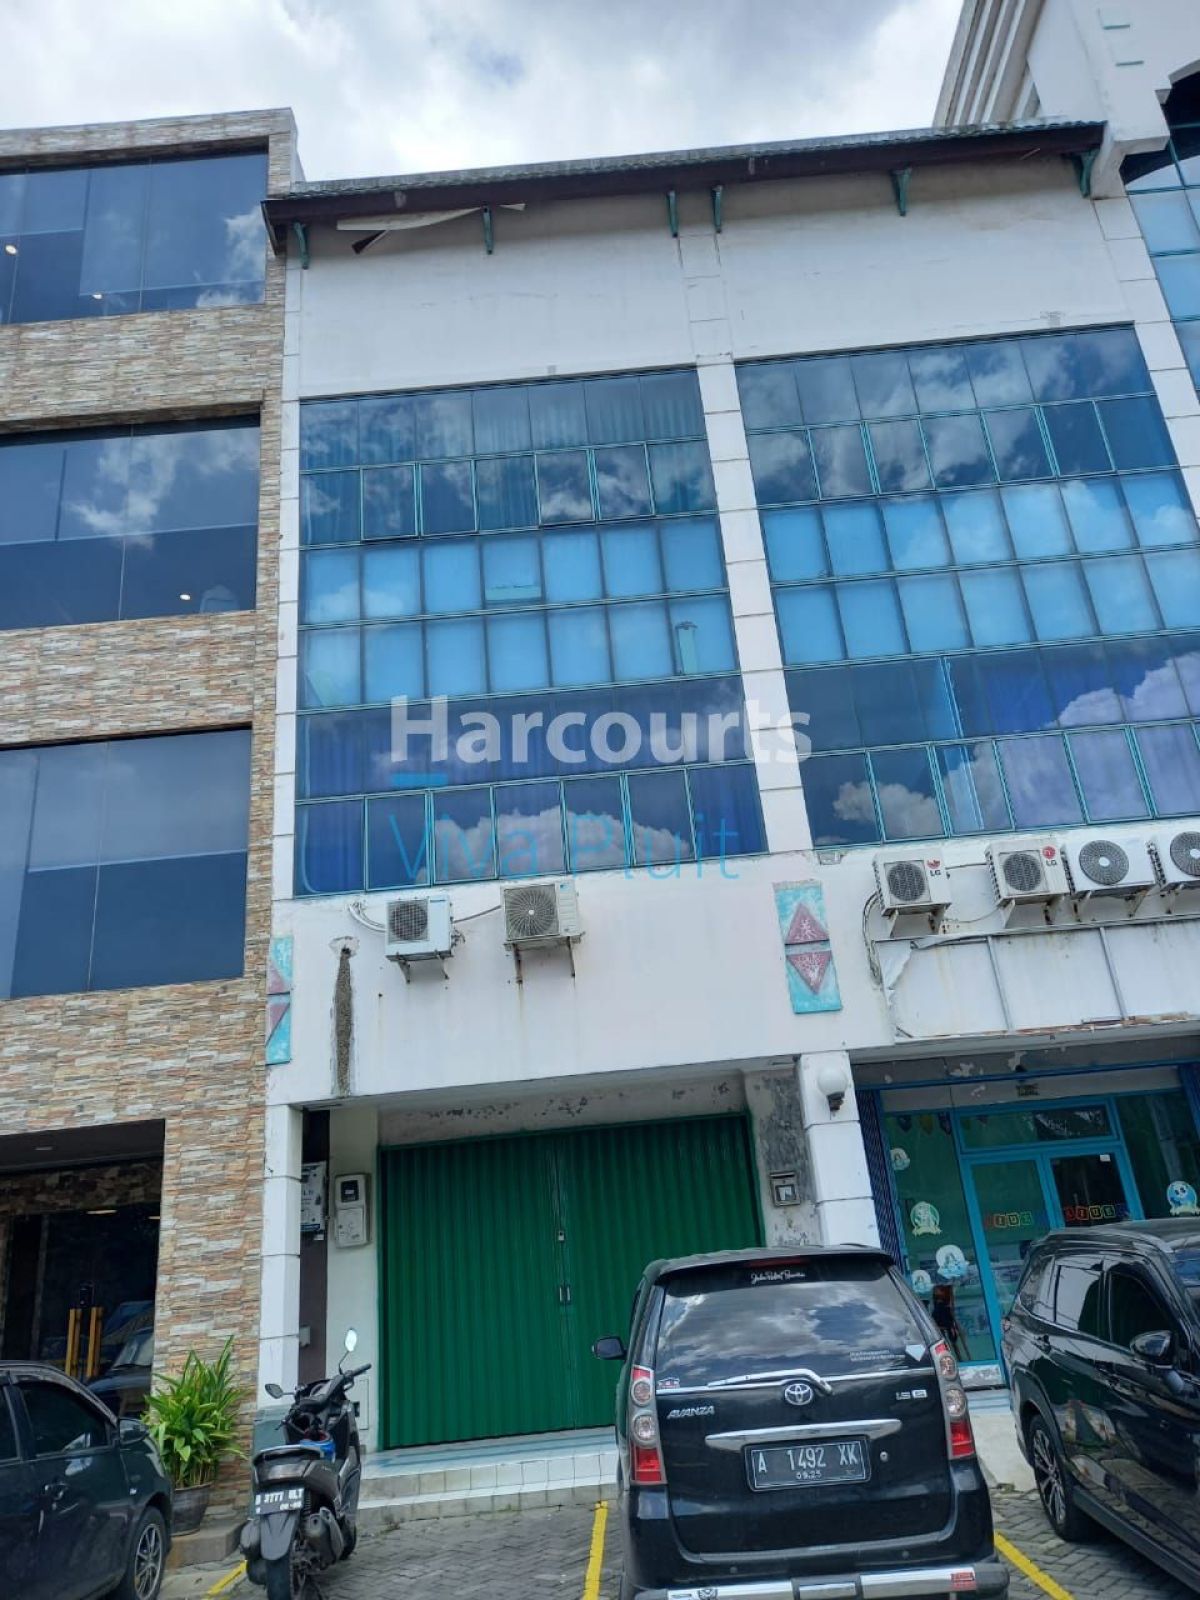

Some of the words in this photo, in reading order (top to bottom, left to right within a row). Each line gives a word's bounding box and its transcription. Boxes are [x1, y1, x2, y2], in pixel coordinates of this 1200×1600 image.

[666, 1405, 715, 1419] AVANZA
[758, 1452, 767, 1473] A
[786, 1447, 826, 1471] 1492
[838, 1443, 858, 1465] XK
